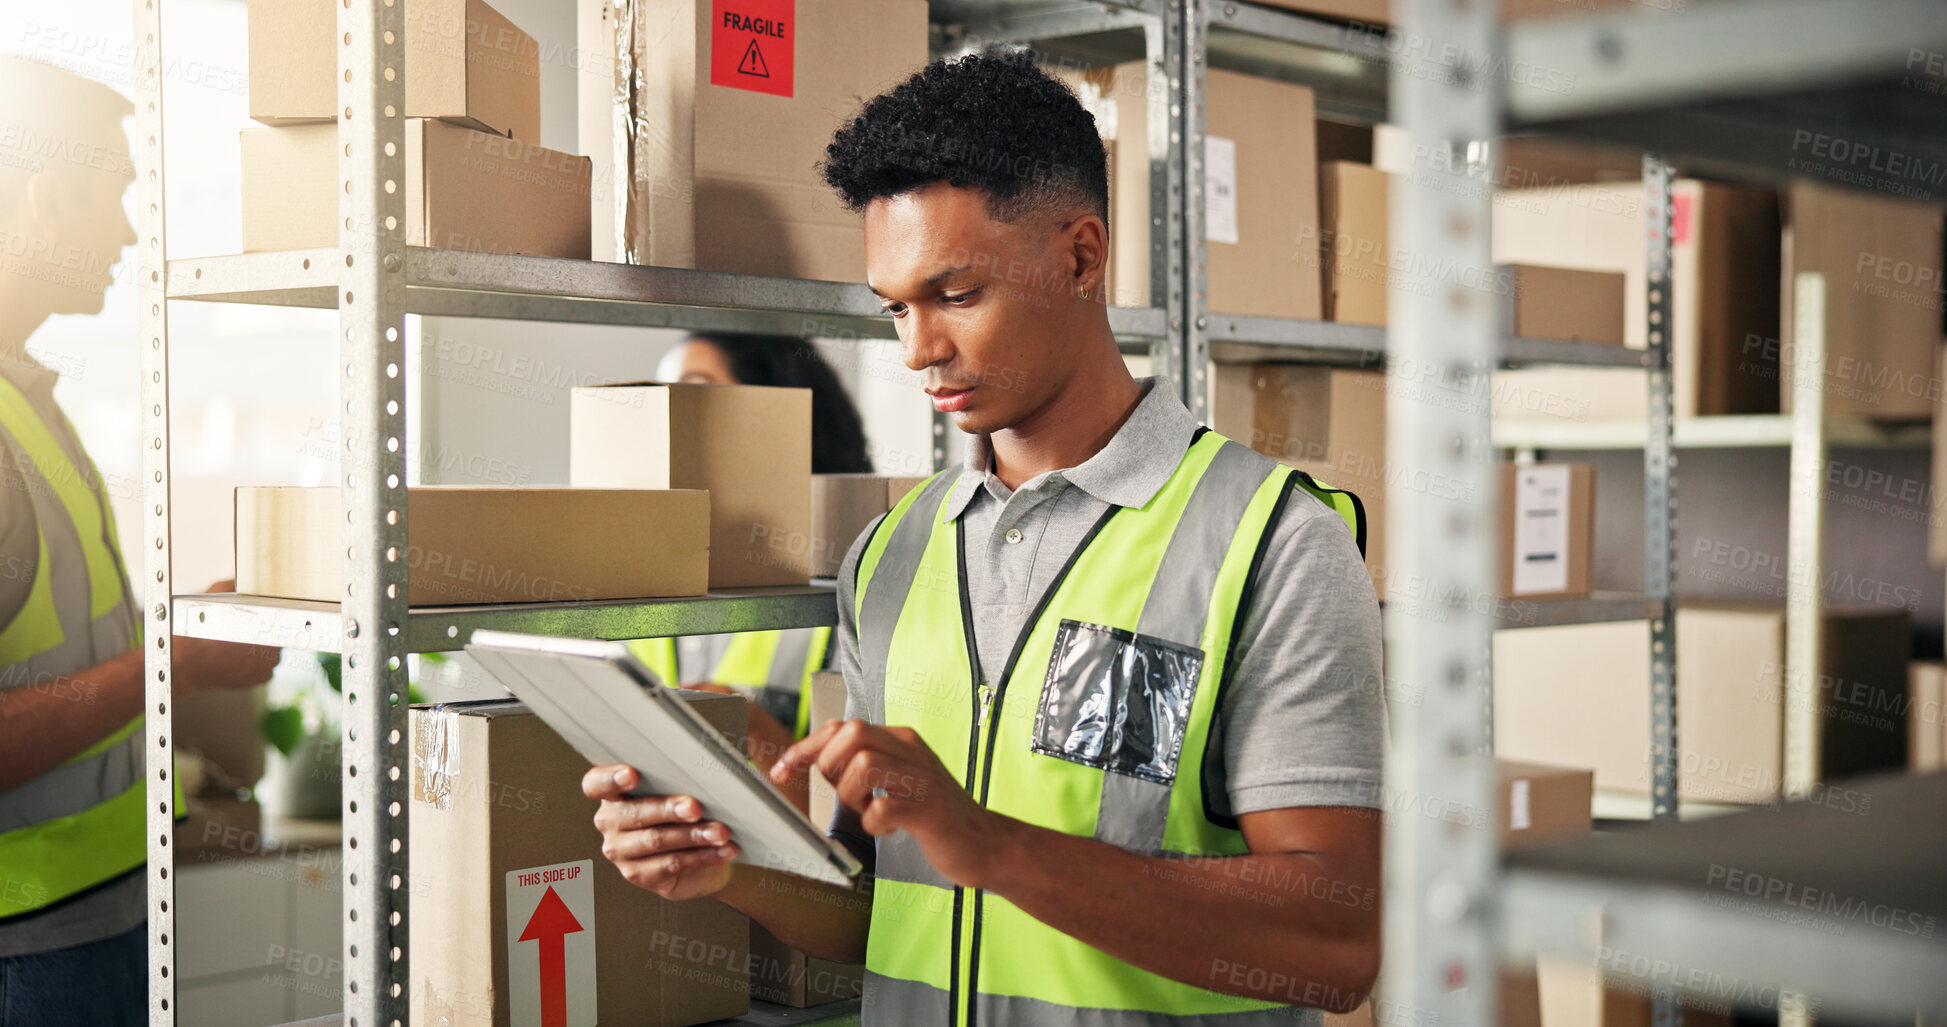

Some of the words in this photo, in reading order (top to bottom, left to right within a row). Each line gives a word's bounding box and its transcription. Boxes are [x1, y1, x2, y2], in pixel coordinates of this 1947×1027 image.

[723, 11, 784, 39] FRAGILE
[518, 872, 540, 887] THIS
[543, 868, 565, 883] SIDE
[567, 866, 581, 880] UP
